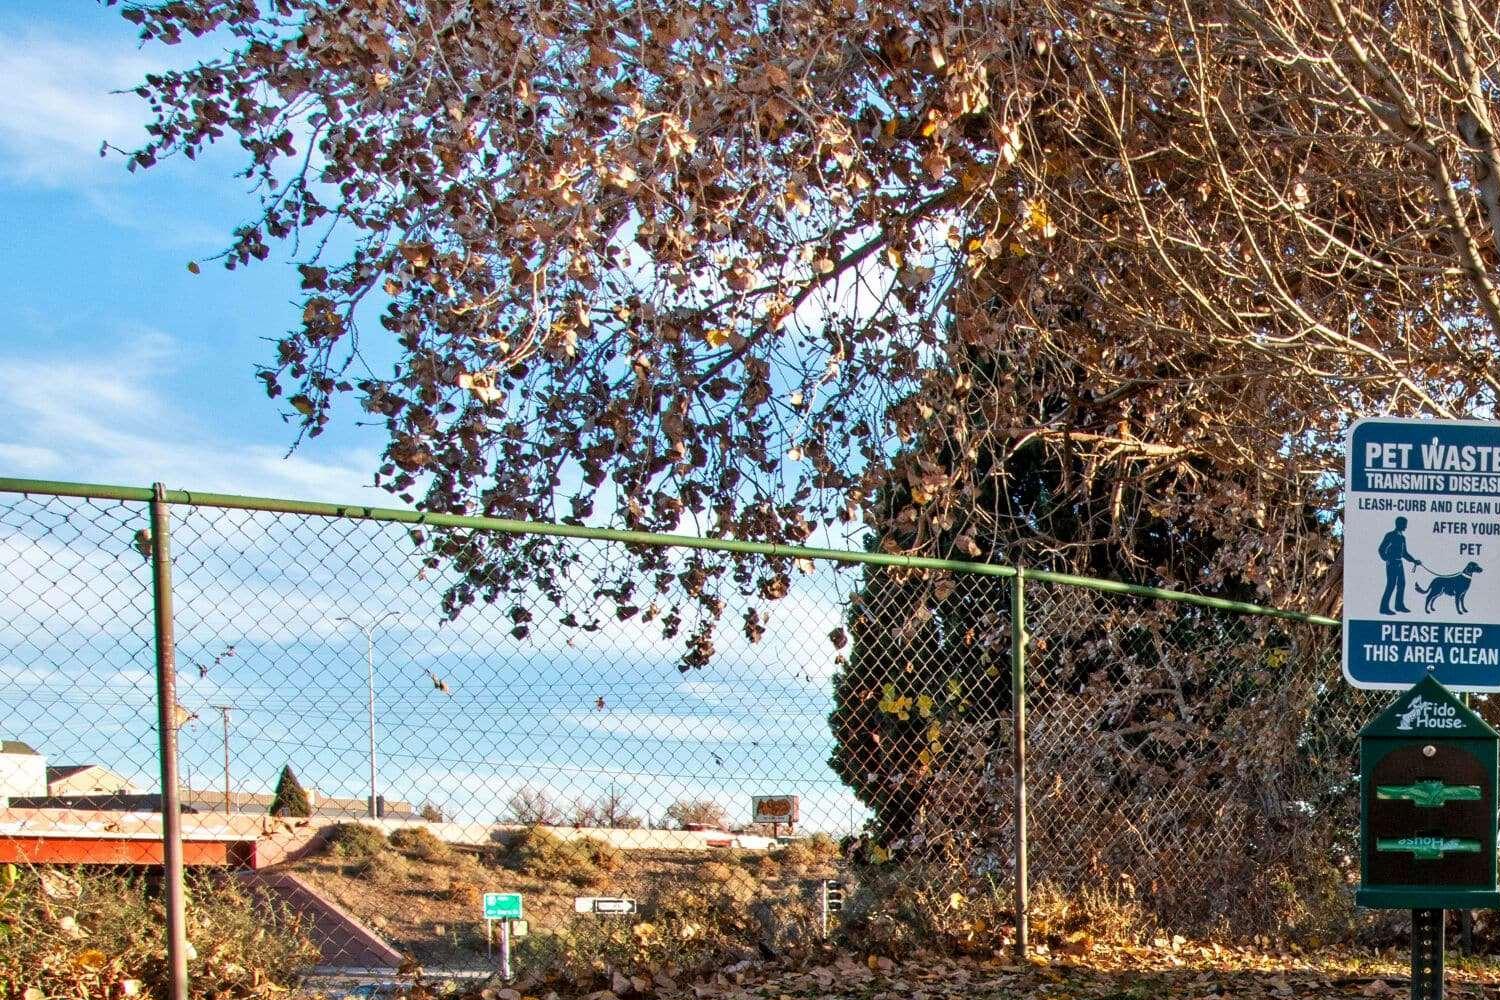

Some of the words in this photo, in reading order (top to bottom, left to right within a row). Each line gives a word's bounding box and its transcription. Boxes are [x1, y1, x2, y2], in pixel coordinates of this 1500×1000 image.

[1365, 442, 1412, 469] PET
[1366, 472, 1444, 491] TRANSMITS
[1358, 498, 1427, 512] LEASH-CURB
[1430, 500, 1452, 513] AND
[1456, 501, 1491, 514] CLEAN
[1433, 521, 1467, 535] AFTER
[1472, 522, 1500, 536] YOUR
[1459, 543, 1482, 556] PET
[1381, 624, 1439, 643] PLEASE
[1443, 626, 1483, 644] KEEP
[1363, 644, 1398, 662] THIS
[1403, 646, 1444, 664] AREA
[1450, 648, 1499, 666] CLEAN
[1423, 701, 1456, 717] Fido
[1416, 714, 1462, 729] House
